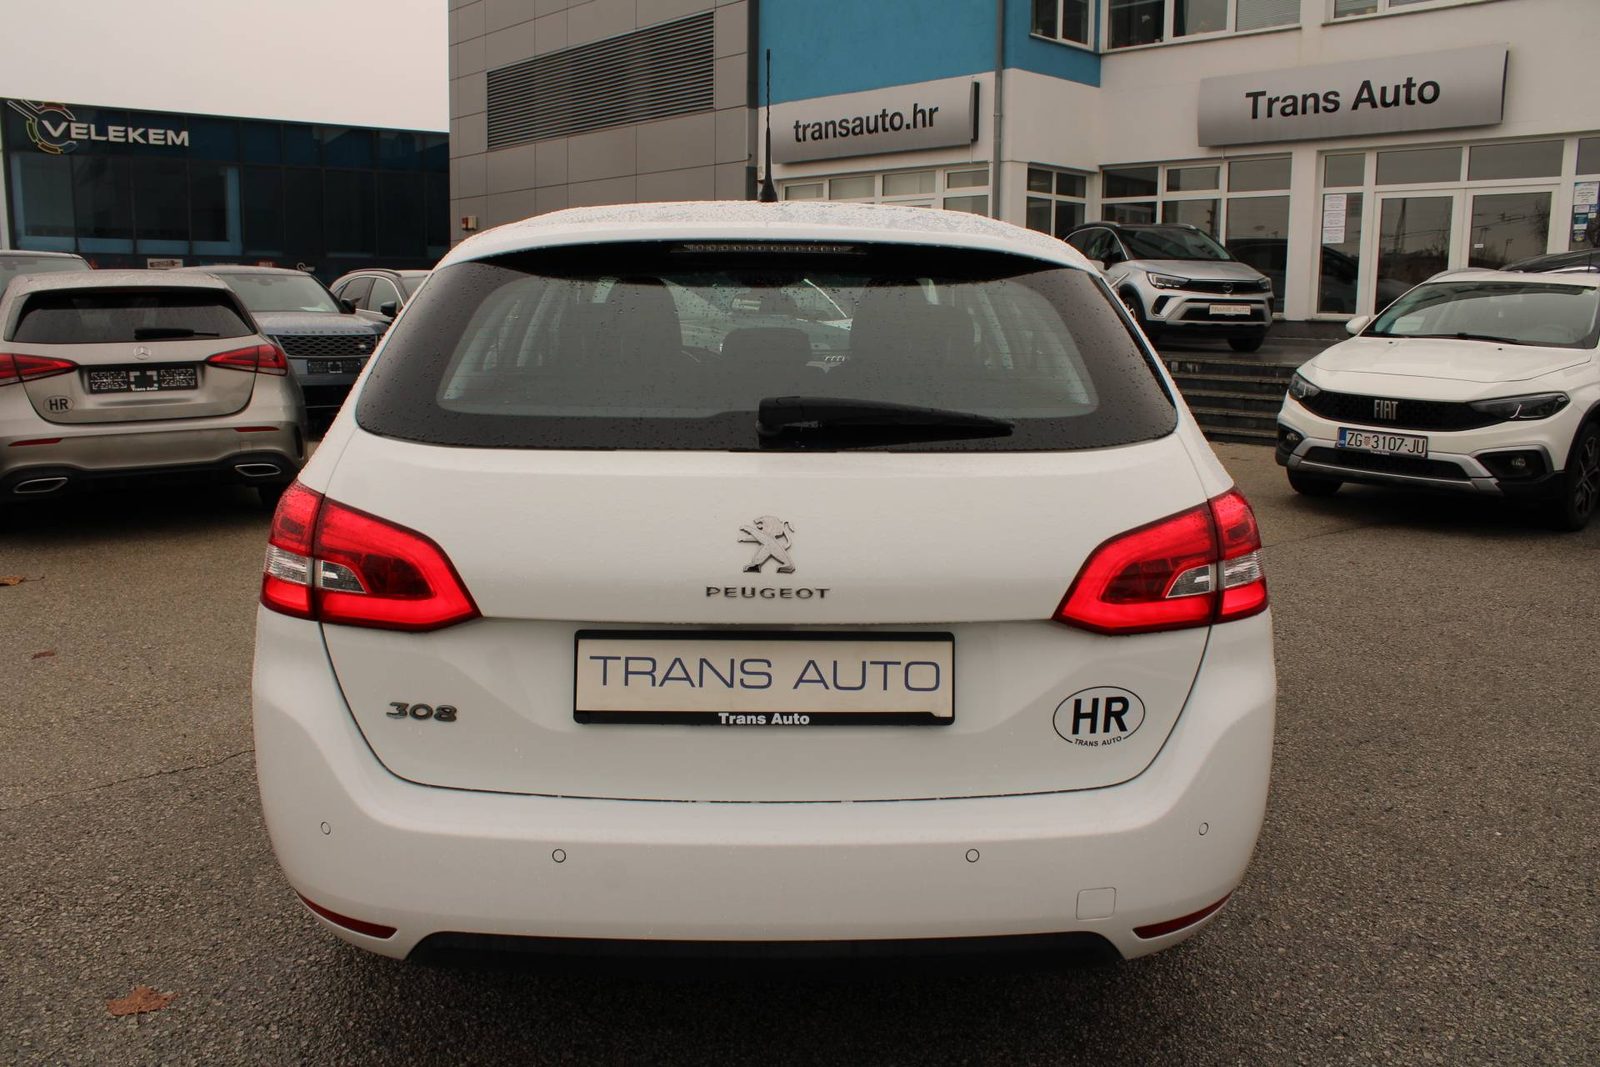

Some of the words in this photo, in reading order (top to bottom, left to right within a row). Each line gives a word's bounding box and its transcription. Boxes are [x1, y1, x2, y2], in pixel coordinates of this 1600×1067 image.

[1245, 90, 1341, 119] Trans
[1351, 77, 1441, 111] Auto
[41, 119, 190, 147] VELEKEM
[793, 103, 939, 143] transauto.hr
[49, 398, 69, 411] HR
[1374, 399, 1399, 420] FIAT
[705, 586, 831, 599] PEUGEOT
[589, 655, 773, 690] TRANS
[792, 659, 941, 692] AUTO
[386, 701, 458, 722] 308
[718, 712, 766, 726] Trans
[771, 712, 810, 726] Auto
[1072, 696, 1130, 735] HR
[1074, 737, 1099, 748] TRANS
[1101, 735, 1122, 746] AUTO
